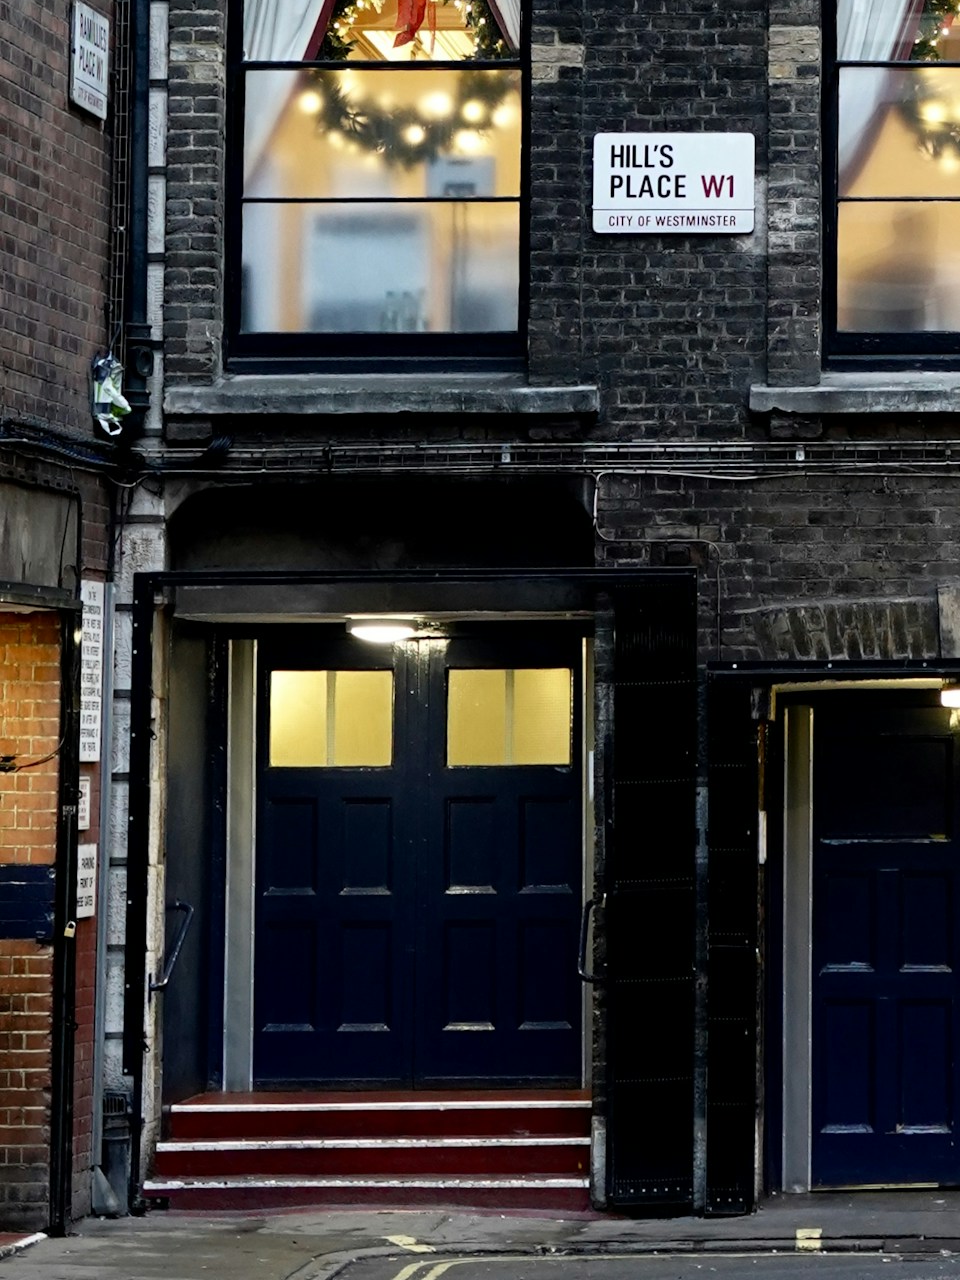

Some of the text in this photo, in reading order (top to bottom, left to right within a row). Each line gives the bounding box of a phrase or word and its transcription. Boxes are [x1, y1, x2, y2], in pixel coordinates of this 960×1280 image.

[80, 13, 106, 52] RAMILLIES
[79, 45, 95, 77] PLACE
[611, 145, 674, 168] HILL'S
[610, 175, 735, 198] PLACE W1
[608, 216, 737, 227] CITY OF WESTMINSTER
